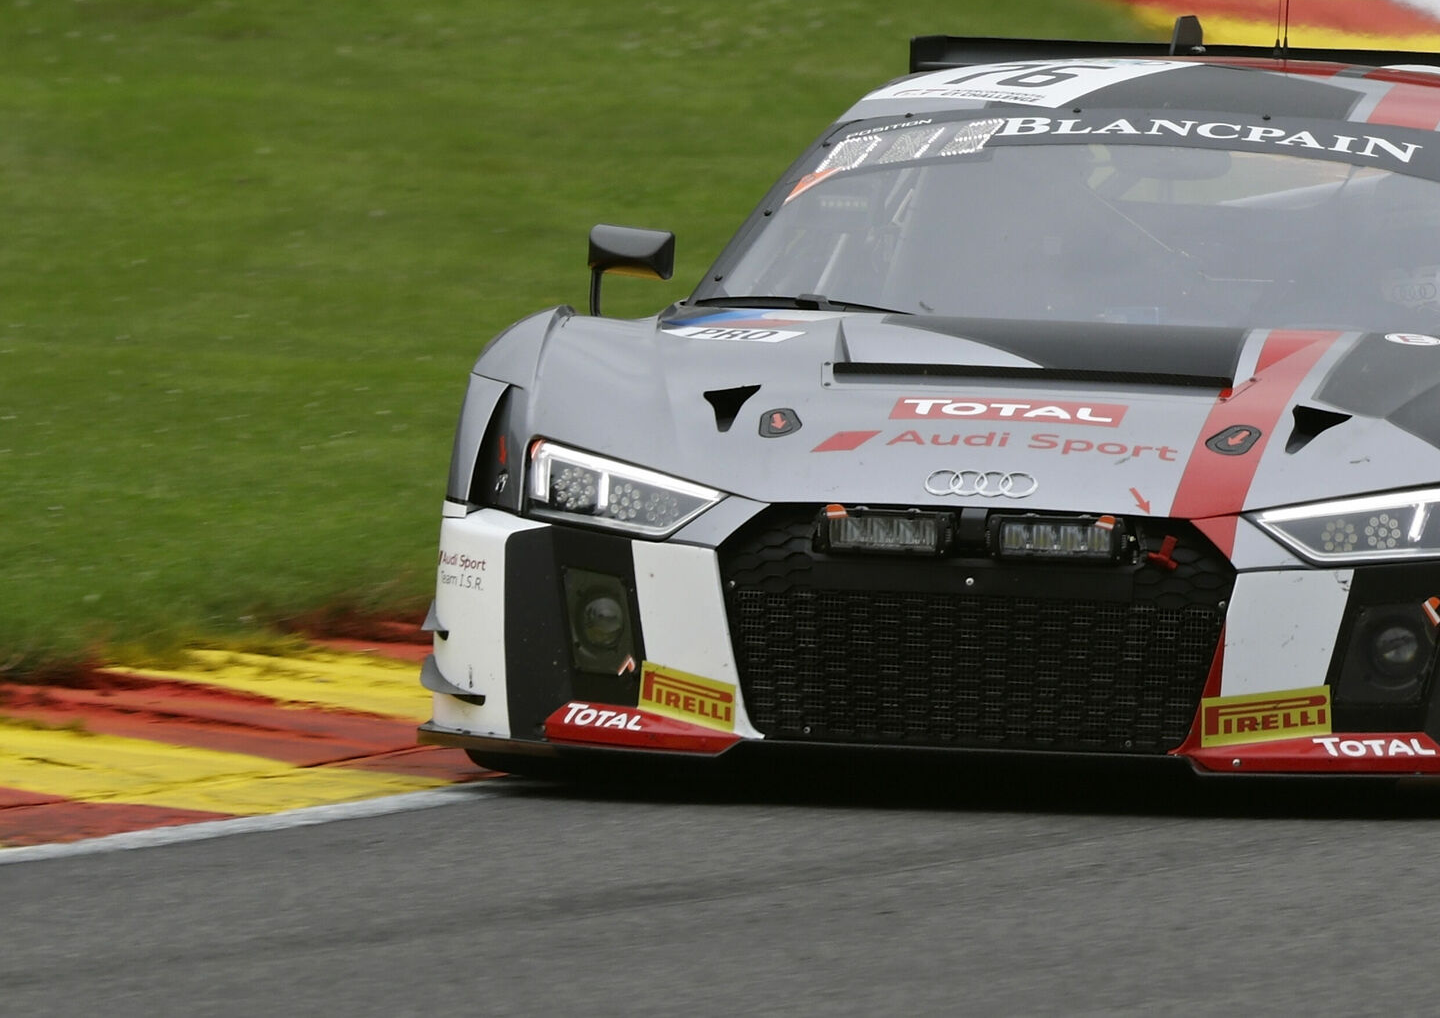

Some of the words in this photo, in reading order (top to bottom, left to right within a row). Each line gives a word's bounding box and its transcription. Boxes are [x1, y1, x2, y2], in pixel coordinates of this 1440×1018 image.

[846, 118, 932, 139] POSITION
[995, 117, 1423, 163] BLANCPAIN
[686, 328, 778, 340] PRO
[904, 398, 1113, 423] TOTAL
[886, 430, 1010, 447] Audi
[1028, 433, 1179, 461] Sport
[459, 554, 487, 571] Sport
[643, 670, 733, 722] PIRELLI
[563, 702, 643, 731] TOTAL
[1205, 695, 1326, 736] PIRELLI
[1312, 737, 1437, 757] TOTAL
